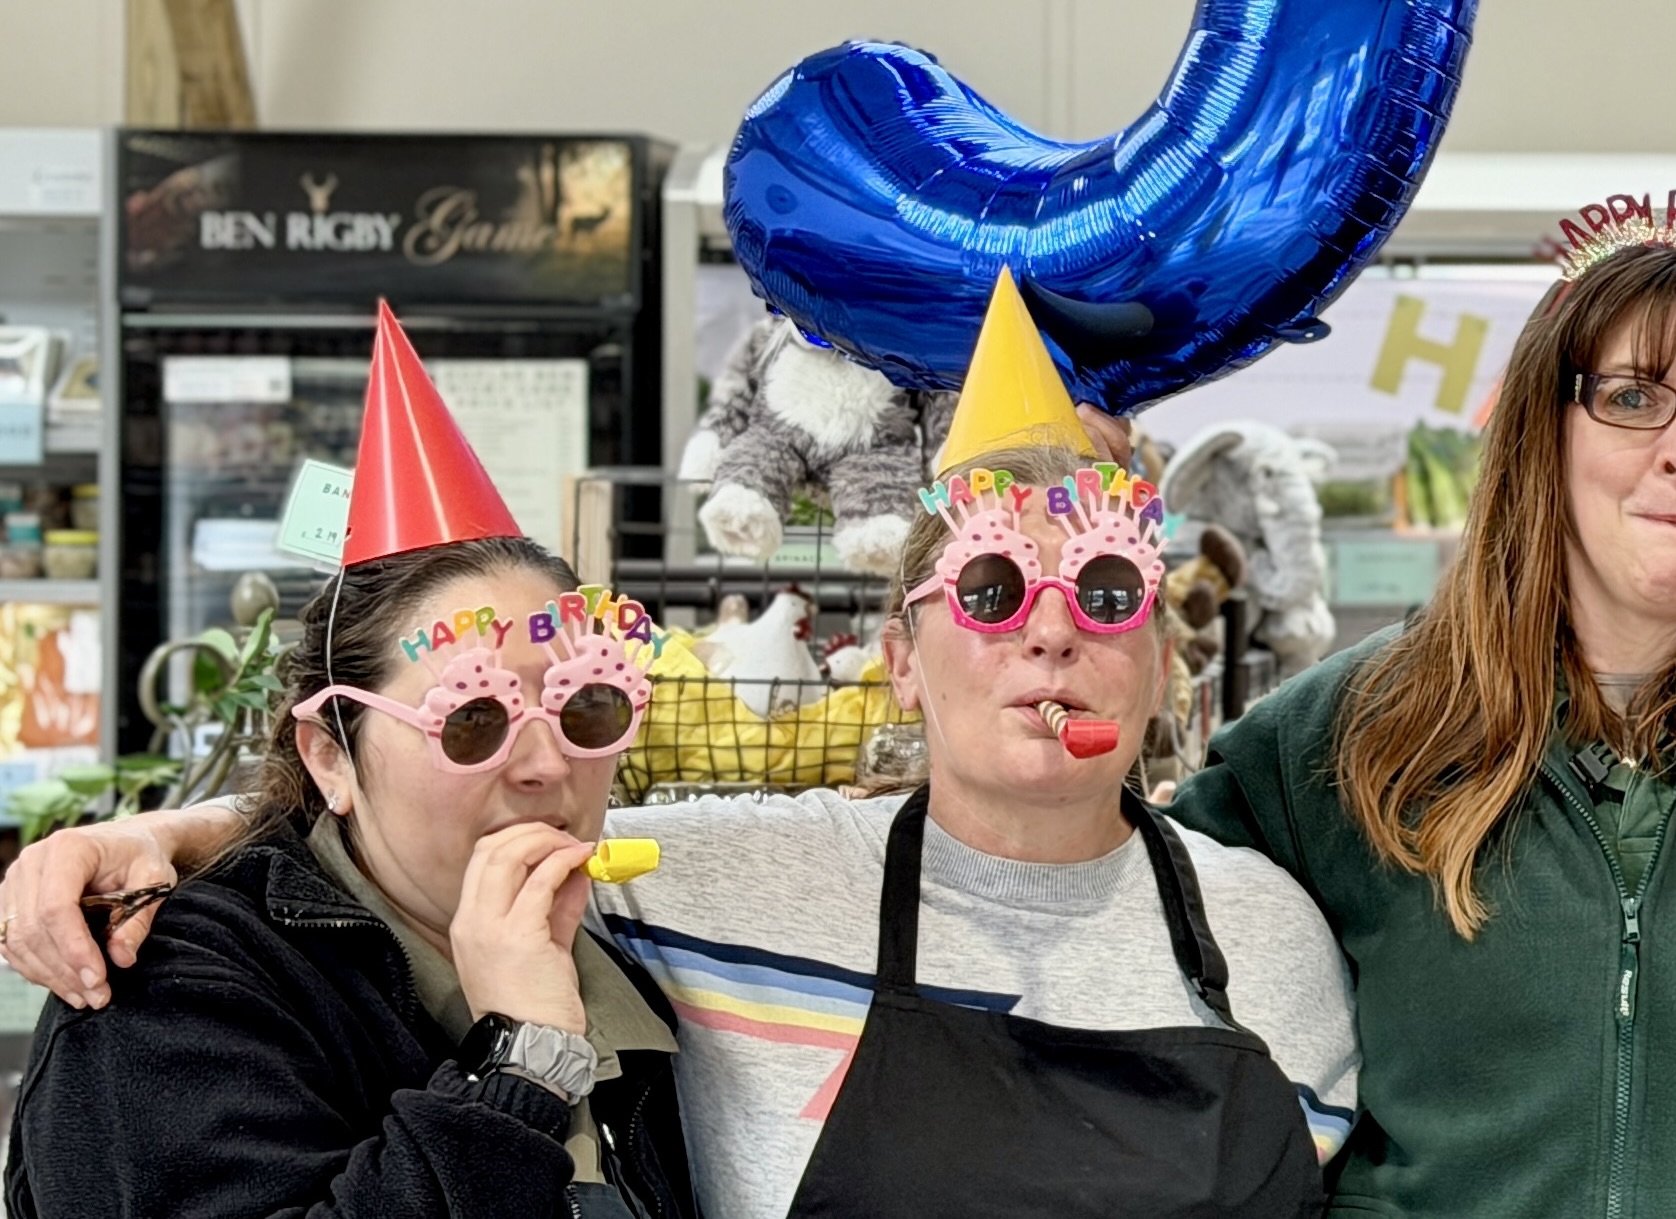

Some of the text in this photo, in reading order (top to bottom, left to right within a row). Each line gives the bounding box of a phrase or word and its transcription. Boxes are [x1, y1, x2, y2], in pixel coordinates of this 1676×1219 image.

[200, 186, 553, 266] BEN RIGBY Game
[1535, 193, 1652, 270] APPY
[322, 483, 351, 499] BAN
[918, 462, 1186, 540] HAPPY BIRTHDAY
[399, 584, 671, 662] HAPPY BIRTHDAY
